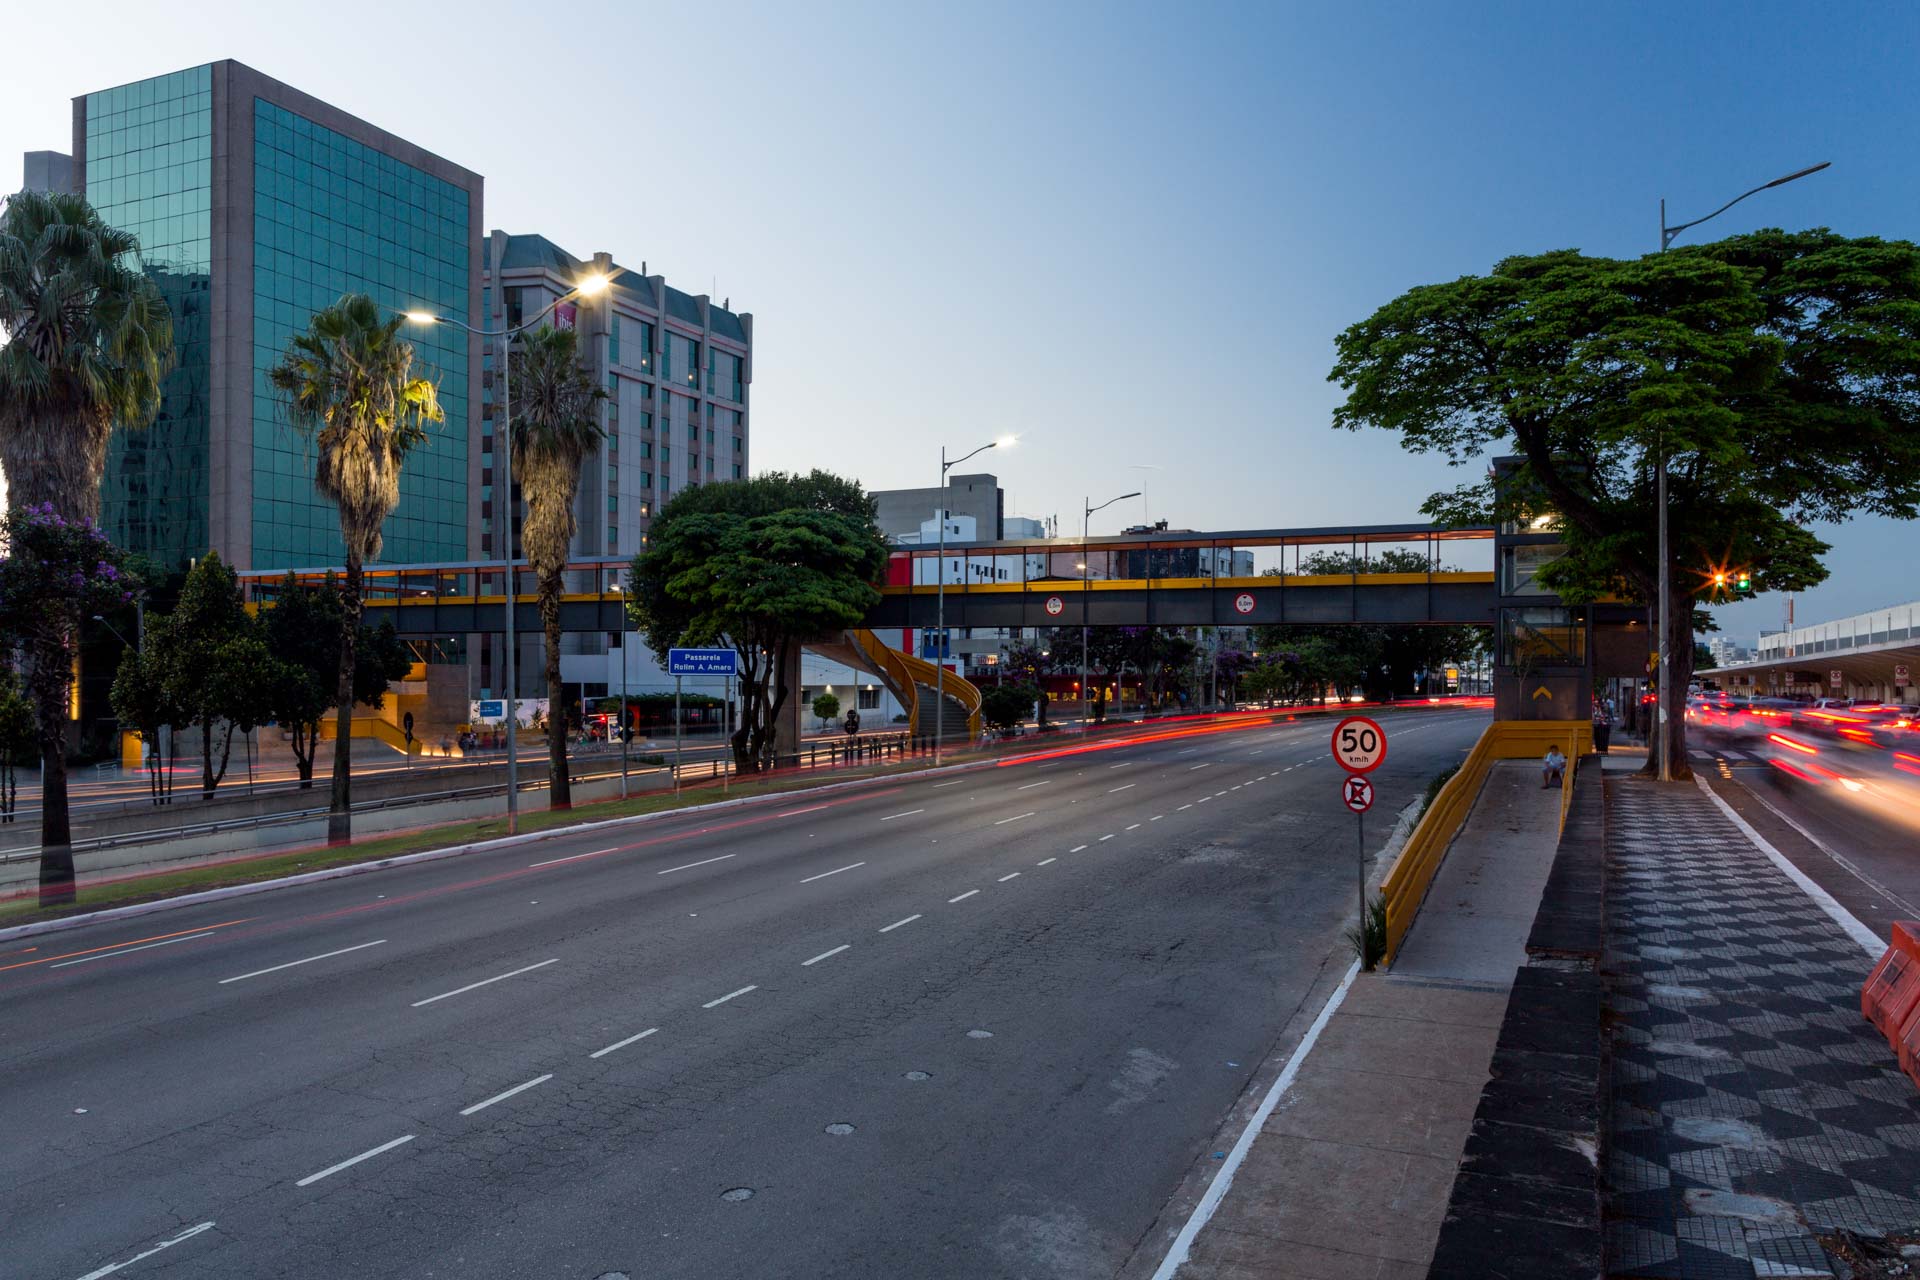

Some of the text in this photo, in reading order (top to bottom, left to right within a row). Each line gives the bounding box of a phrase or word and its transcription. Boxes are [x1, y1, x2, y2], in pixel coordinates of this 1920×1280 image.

[559, 311, 573, 332] ibis
[684, 653, 721, 661] Passarela
[674, 663, 695, 671] Rolim
[707, 663, 732, 671] Amaro
[1342, 728, 1377, 753] 50
